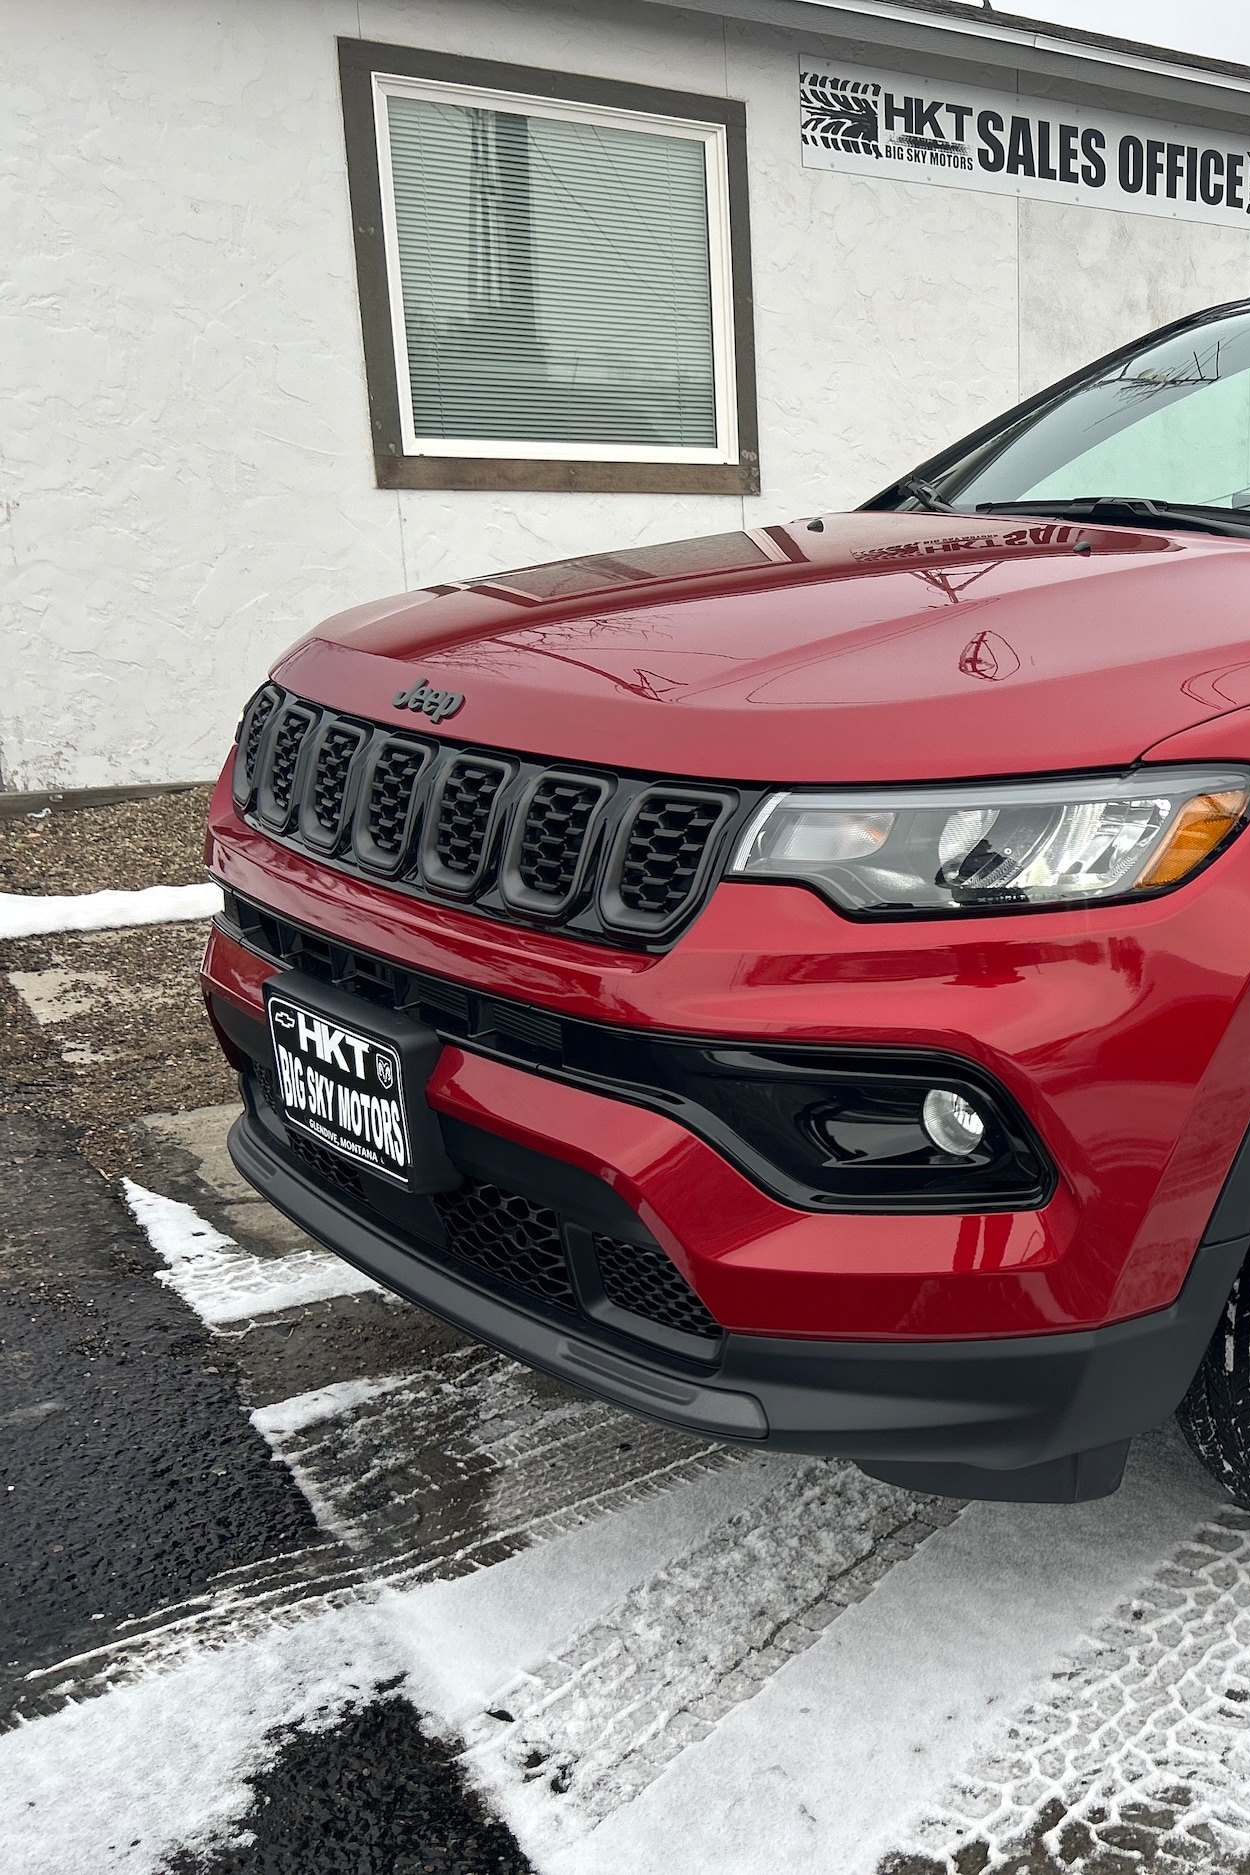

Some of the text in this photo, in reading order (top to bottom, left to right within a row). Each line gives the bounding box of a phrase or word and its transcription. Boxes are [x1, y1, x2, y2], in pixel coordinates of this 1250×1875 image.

[884, 92, 973, 142] HKT
[885, 144, 973, 171] BIG SKY MOTORS
[977, 110, 1244, 209] SALES OFFICE
[392, 677, 466, 725] Jeep
[297, 1012, 370, 1080] HKT
[278, 1044, 405, 1167] BIG SKY MOTORS
[309, 1118, 379, 1163] GLENDIVE, MONTANA
